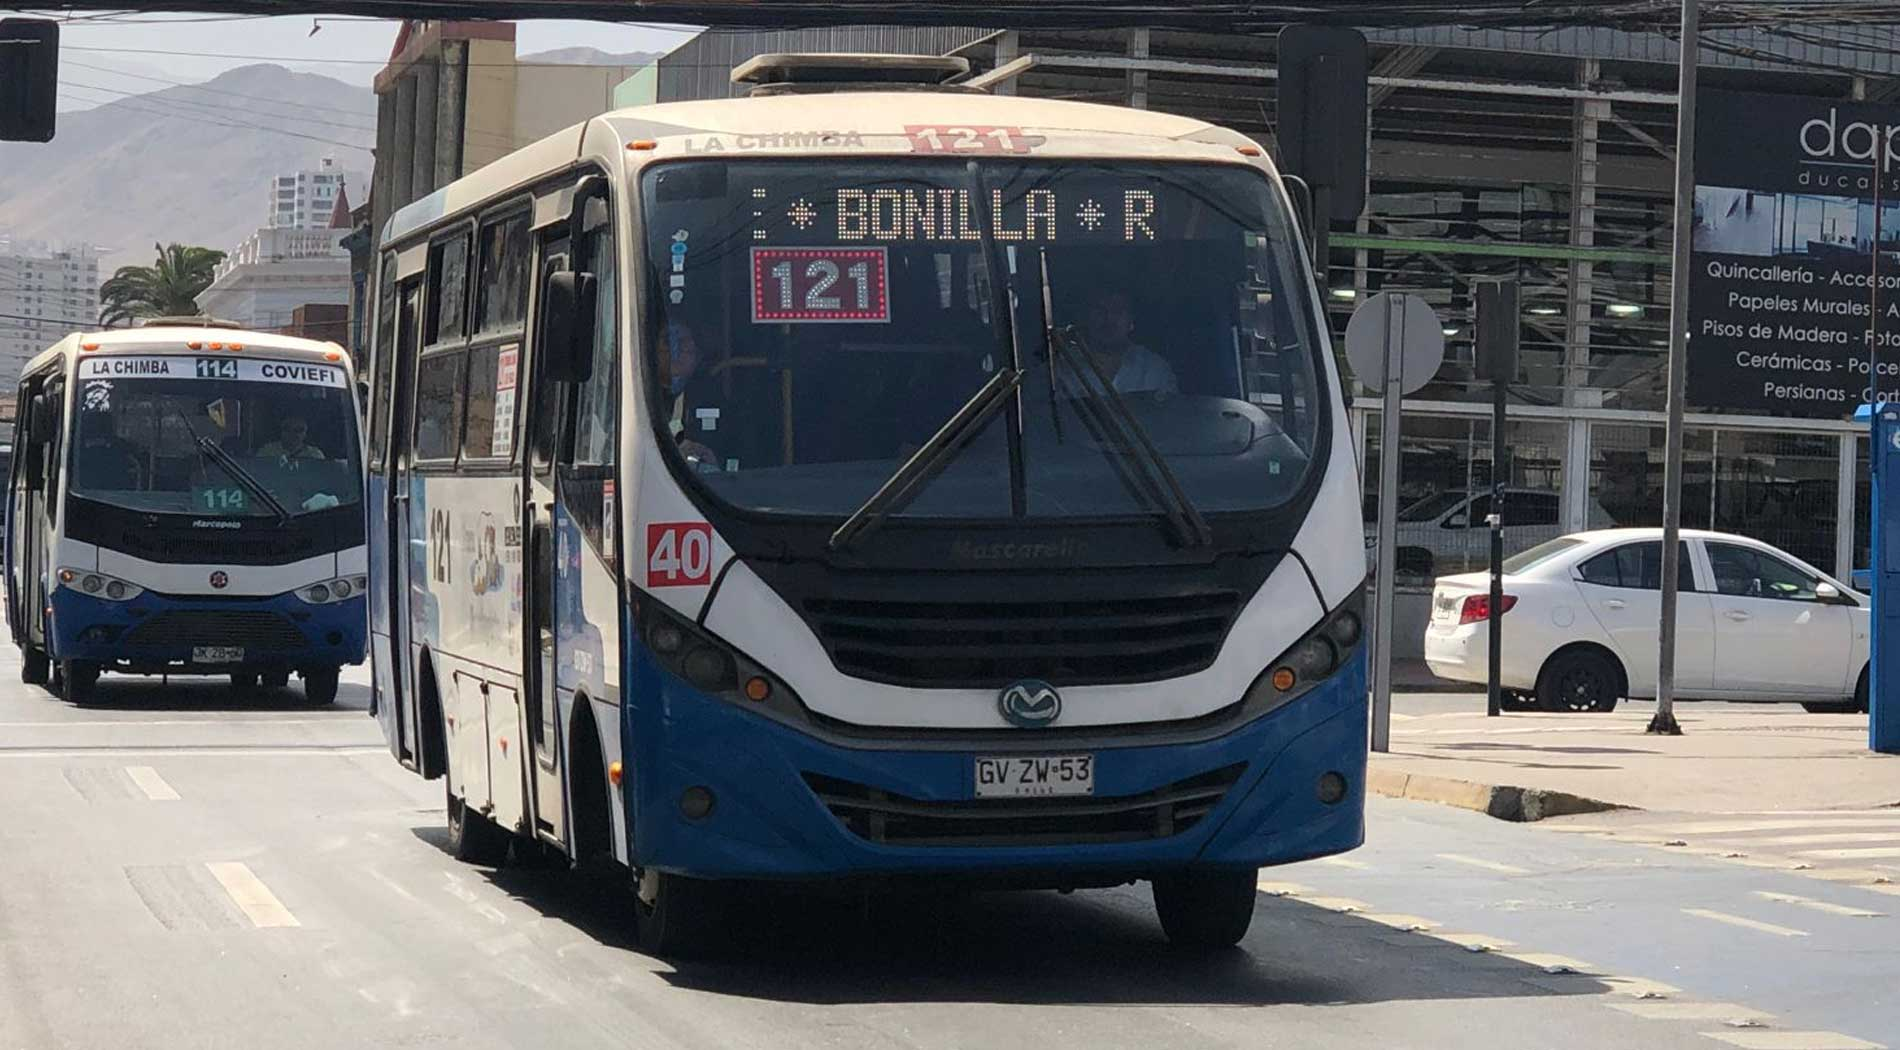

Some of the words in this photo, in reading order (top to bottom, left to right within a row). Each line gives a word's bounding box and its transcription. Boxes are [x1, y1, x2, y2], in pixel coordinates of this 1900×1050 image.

[685, 136, 725, 154] LA
[736, 131, 865, 148] CHIMBA
[917, 127, 1014, 150] 121
[837, 188, 1056, 241] BONILLA
[1125, 189, 1155, 241] R
[771, 259, 870, 310] 121
[1707, 261, 1813, 284] Quincallería
[1728, 291, 1798, 312] Papeles
[1802, 297, 1871, 317] Murales
[1703, 319, 1744, 338] Pisos
[1748, 322, 1773, 339] de
[1778, 325, 1848, 344] Madera
[92, 361, 110, 374] LA
[114, 361, 170, 375] CHIMBA
[198, 359, 236, 377] 114
[261, 364, 335, 383] COVIEFI
[1736, 350, 1832, 372] Cerámicas
[1764, 381, 1846, 401] Persianas
[203, 489, 243, 509] 114
[430, 507, 451, 585] 121
[650, 528, 710, 579] 40
